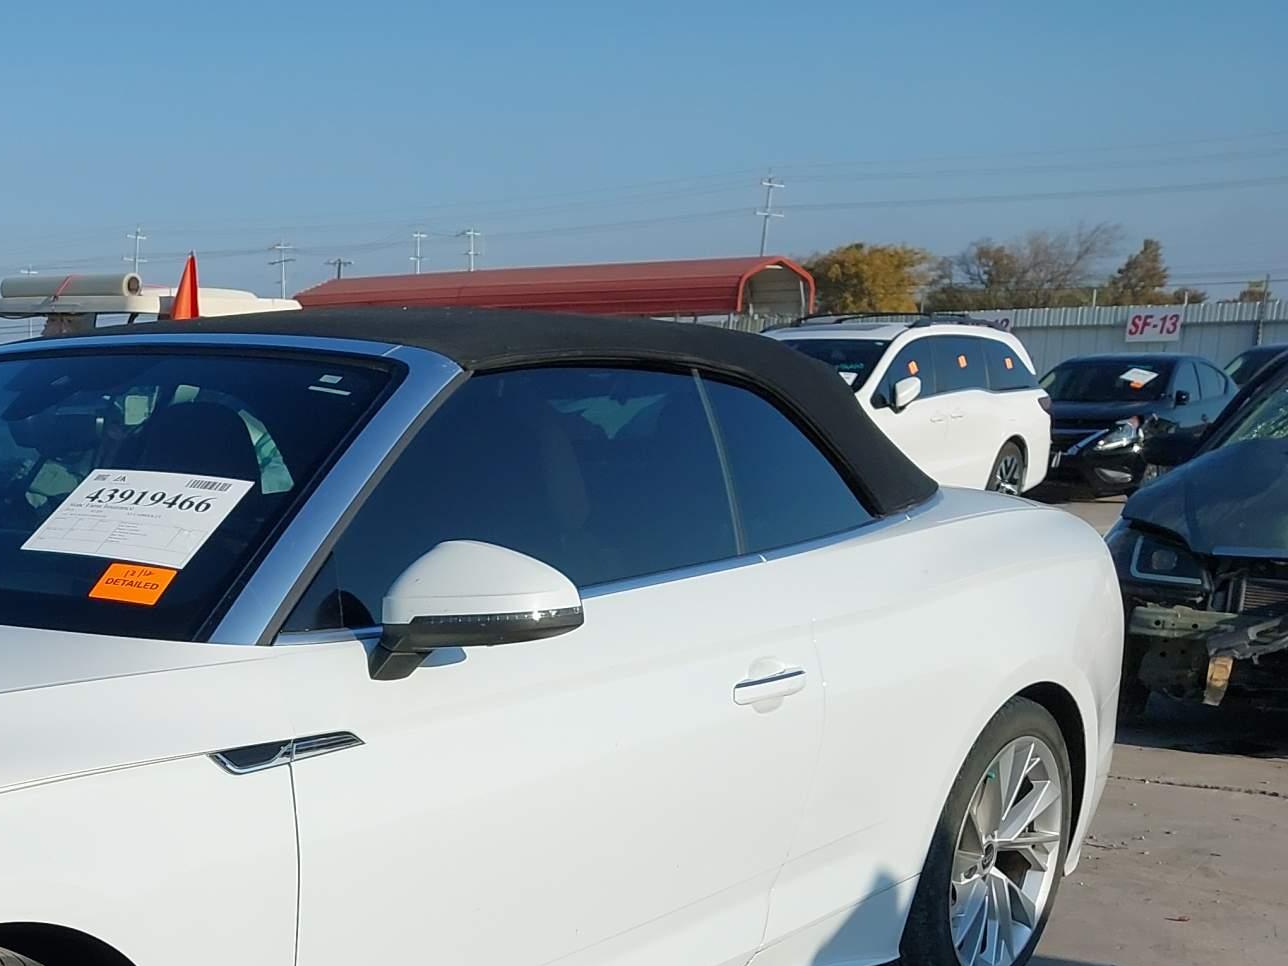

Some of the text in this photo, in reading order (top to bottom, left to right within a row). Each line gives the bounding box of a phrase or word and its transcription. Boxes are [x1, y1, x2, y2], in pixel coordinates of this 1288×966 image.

[1128, 313, 1180, 336] SF-13
[85, 487, 217, 513] 43919466
[105, 577, 160, 590] DETAILED
